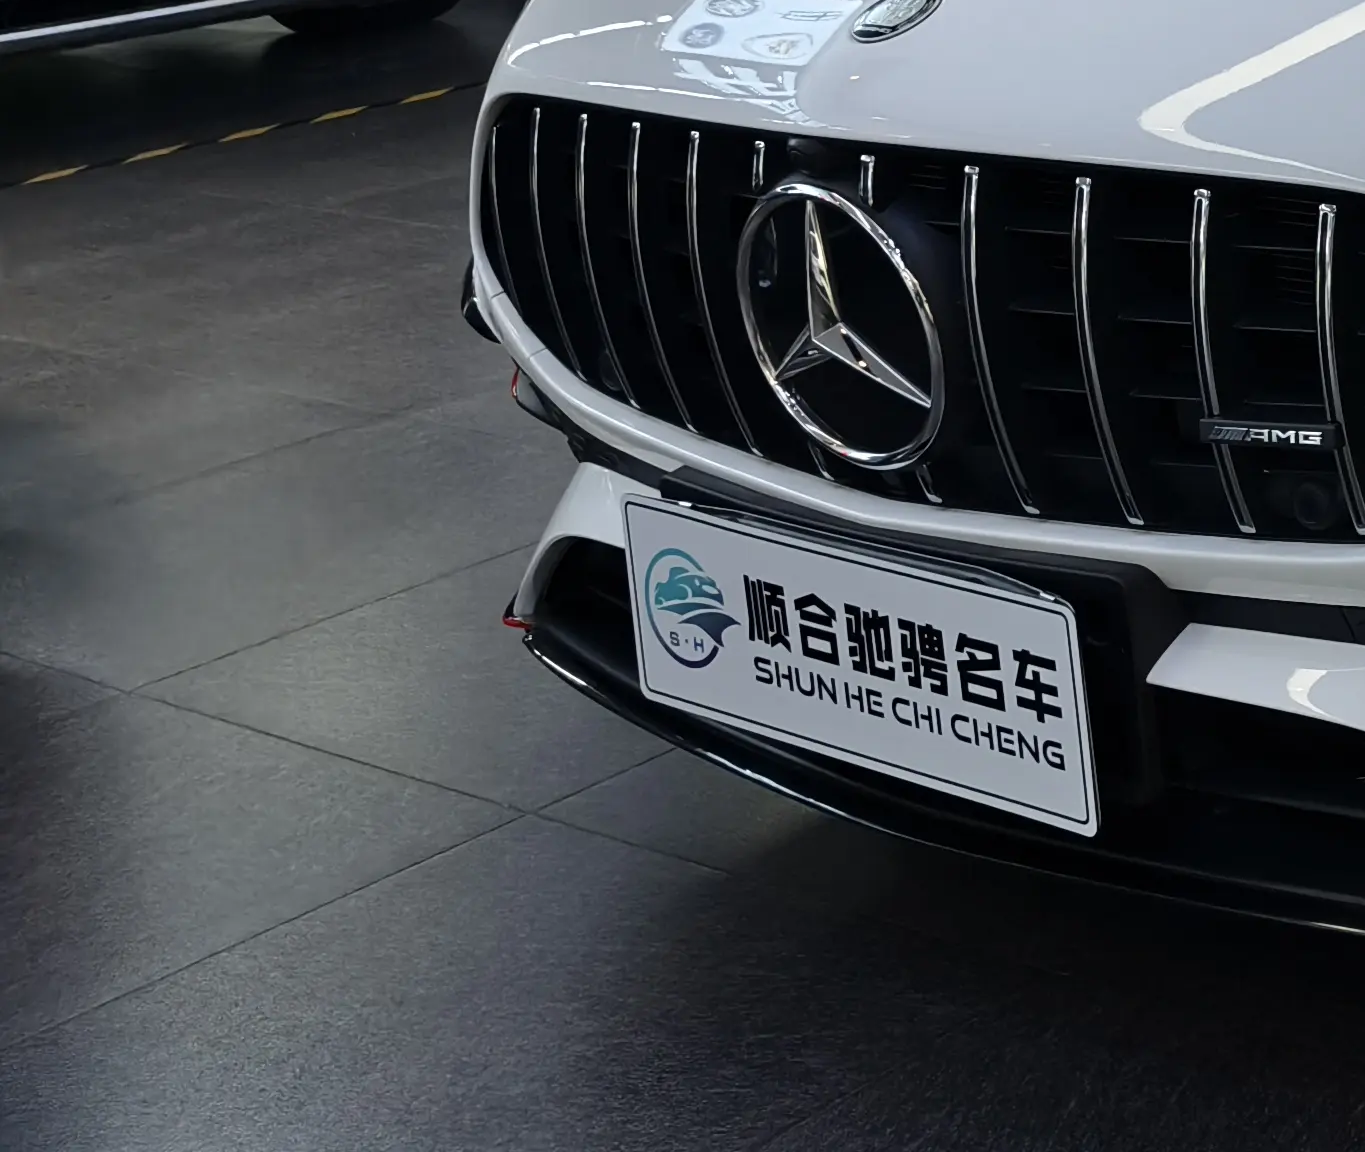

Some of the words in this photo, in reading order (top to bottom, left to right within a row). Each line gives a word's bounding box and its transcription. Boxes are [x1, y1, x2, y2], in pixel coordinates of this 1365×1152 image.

[742, 573, 1064, 724] 顺合驰骋名车
[754, 655, 838, 706] SHUN
[845, 683, 885, 719] HE
[891, 696, 943, 736] CHI
[949, 713, 1066, 772] CHENG
